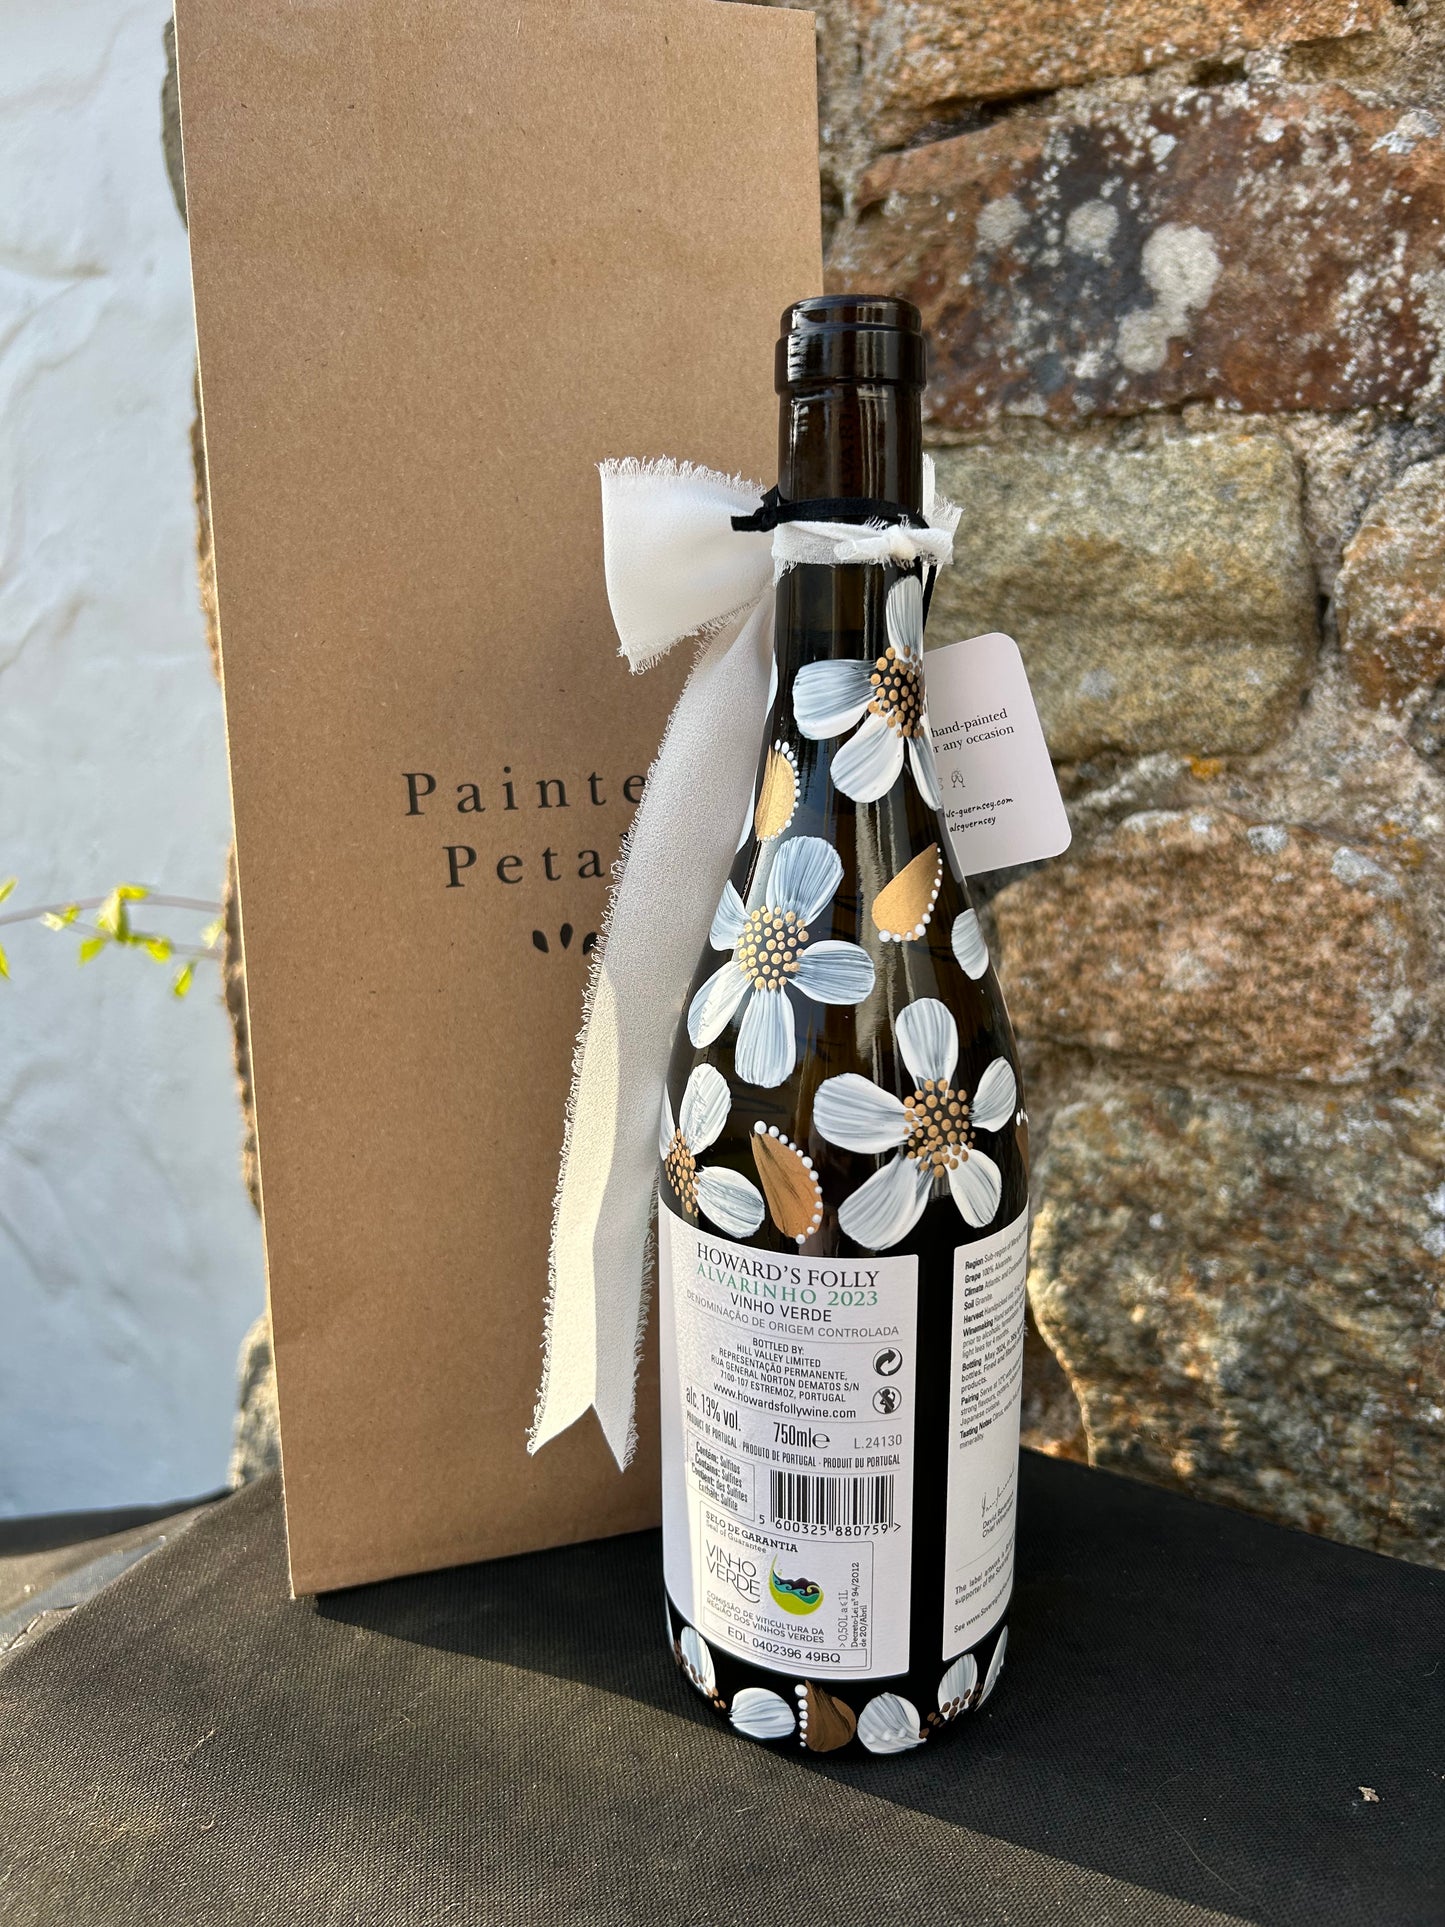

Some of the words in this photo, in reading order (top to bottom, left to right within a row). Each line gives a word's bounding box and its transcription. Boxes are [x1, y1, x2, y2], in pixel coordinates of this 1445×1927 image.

[931, 708, 1007, 738] hand-painted
[943, 740, 963, 751] any
[966, 726, 1014, 745] occasion
[443, 832, 628, 888] Peta
[697, 1242, 801, 1285] HOWARD'S
[807, 1269, 880, 1288] FOLLY
[964, 1272, 981, 1283] Grape
[965, 1257, 983, 1270] Region
[697, 1262, 816, 1305] ALVARINHO
[827, 1290, 878, 1306] 2023
[964, 1284, 984, 1297] Climate
[686, 1289, 749, 1324] DENOMINAÇÃO
[752, 1316, 765, 1328] DE
[769, 1321, 814, 1336] ORIGEM
[818, 1326, 899, 1338] CONTROLADA
[730, 1292, 774, 1315] VINHO
[780, 1304, 832, 1322] VERDE
[964, 1299, 975, 1310] Soil
[964, 1310, 984, 1324] Harvest
[963, 1318, 994, 1337] Winemaking
[737, 1343, 753, 1356] HILL
[754, 1348, 783, 1363] VALLEY
[785, 1355, 821, 1368] LIMITED
[752, 1337, 789, 1352] BOTTLED
[711, 1354, 724, 1367] RUA
[726, 1361, 758, 1380] GENERAL
[760, 1373, 795, 1388] NORTON
[798, 1379, 841, 1391] DEMATOS
[844, 1383, 860, 1392] S/N
[719, 1347, 782, 1373] REPRESENTAÇÃO
[962, 1358, 982, 1372] Bottling
[714, 1382, 857, 1418] www.howardsfollywine.com
[721, 1370, 749, 1388] 7100-107
[799, 1391, 846, 1403] PORTUGAL
[961, 1392, 979, 1406] Pairing
[686, 1386, 699, 1410] alc.
[701, 1394, 720, 1422] 13%
[723, 1409, 741, 1432] vol.
[854, 1434, 902, 1449] L.24130
[960, 1410, 985, 1427] Japanese
[960, 1425, 978, 1439] Tasting
[979, 1417, 993, 1431] Notes
[712, 1427, 737, 1449] PORTUGAL
[742, 1441, 769, 1459] PRODUTO
[772, 1449, 780, 1462] DE
[782, 1452, 816, 1467] PORTUGAL
[823, 1457, 852, 1469] PRODUIT
[855, 1457, 865, 1468] DU
[867, 1453, 900, 1468] PORTUGAL
[706, 1510, 726, 1528] SELO
[728, 1522, 740, 1535] DE
[741, 1530, 798, 1553] GARANTIA
[759, 1514, 765, 1525] 5
[775, 1518, 827, 1536] 600325
[728, 1533, 767, 1553] Guarantee
[706, 1539, 757, 1577] VINHO
[706, 1556, 760, 1602] VERDE
[851, 1562, 860, 1597] 94/2012
[955, 1583, 967, 1595] The
[969, 1571, 983, 1588] label
[707, 1590, 741, 1614] COMISSÃO
[743, 1609, 754, 1620] DE
[755, 1615, 809, 1634] VITICULTURA
[811, 1627, 824, 1636] DA
[860, 1605, 868, 1637] 20/Abril
[734, 1613, 751, 1627] DOS
[752, 1622, 786, 1638] VINHOS
[787, 1631, 824, 1644] VERDES
[954, 1622, 966, 1634] See
[727, 1625, 750, 1645] EDL
[752, 1637, 802, 1660] 0402396
[805, 1650, 841, 1664] 49BQ
[860, 1638, 867, 1647] de
